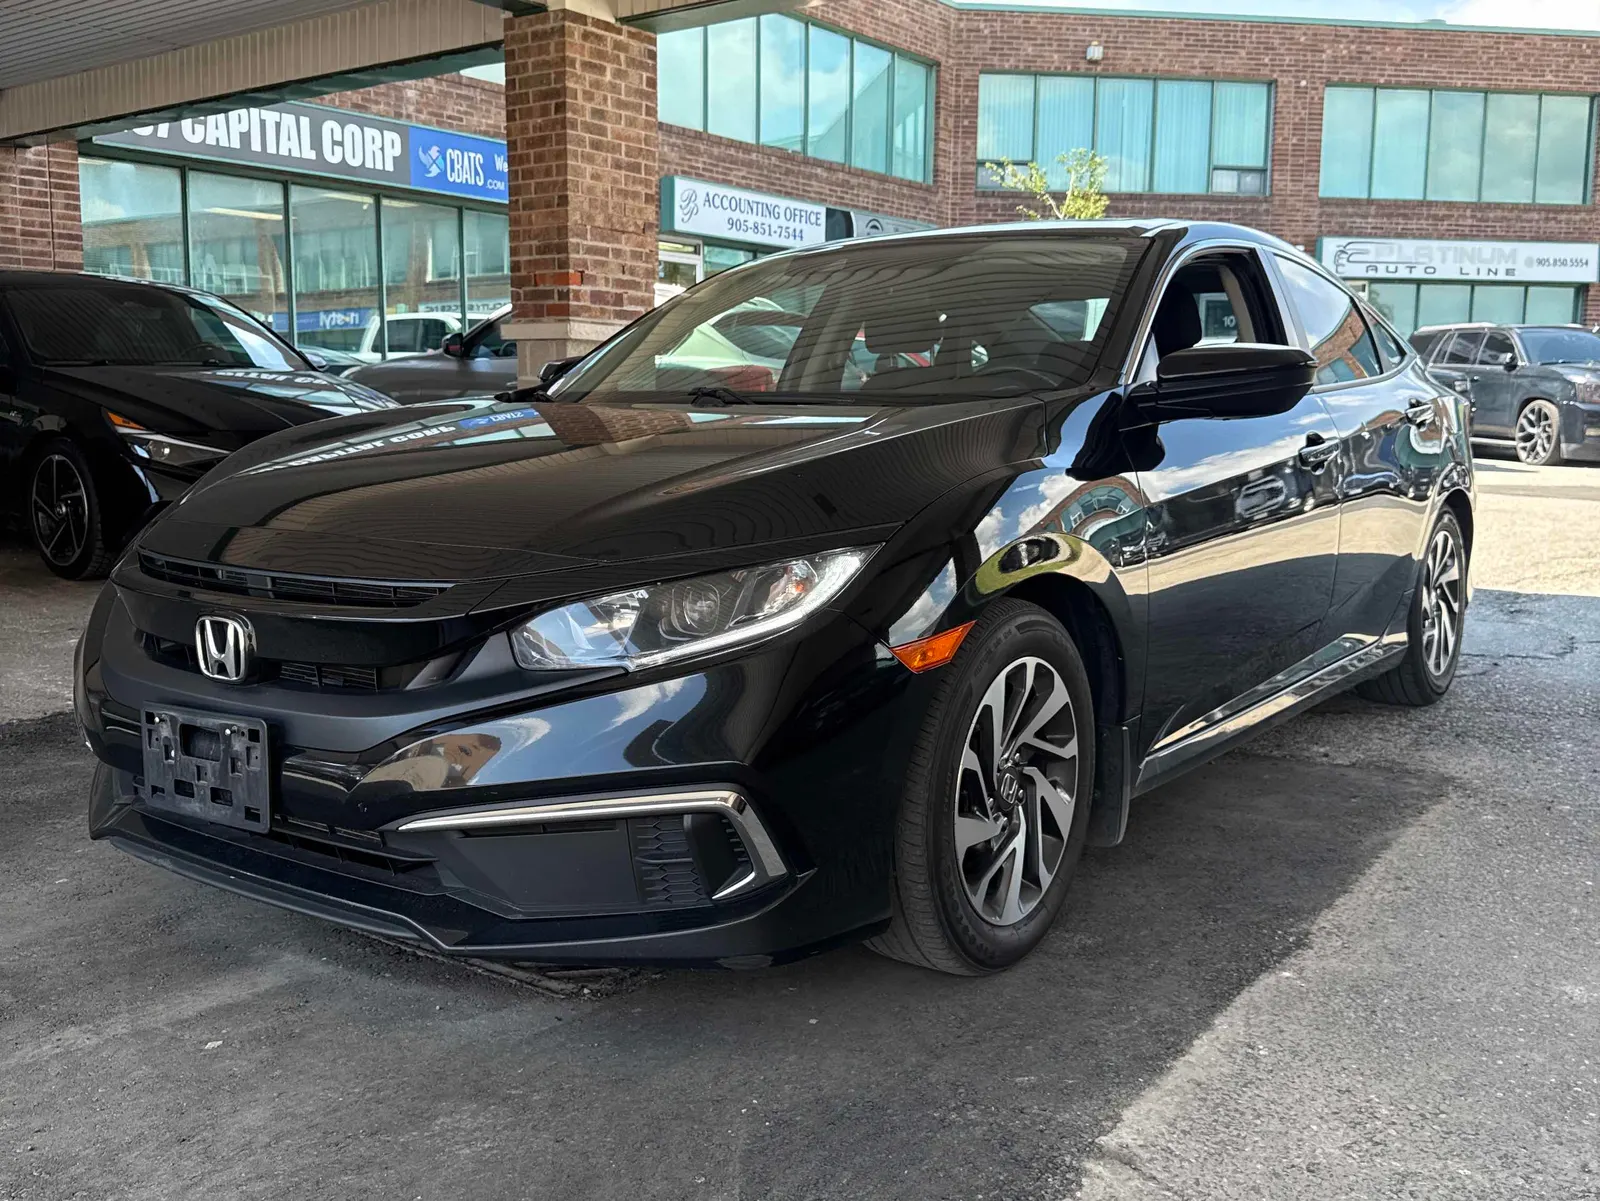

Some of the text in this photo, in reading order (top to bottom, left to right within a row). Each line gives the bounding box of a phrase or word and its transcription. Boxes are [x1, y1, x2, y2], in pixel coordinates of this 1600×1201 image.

[181, 107, 402, 172] CAPITAL CORP
[446, 148, 484, 186] CBATS
[703, 191, 822, 227] ACCOUNTING OFFICE
[727, 217, 804, 241] 905-851-7544
[1374, 244, 1517, 265] PLATINUM
[1535, 256, 1589, 269] 905.850.5554
[1365, 264, 1517, 277] AUTO LINE
[1222, 315, 1237, 328] 10
